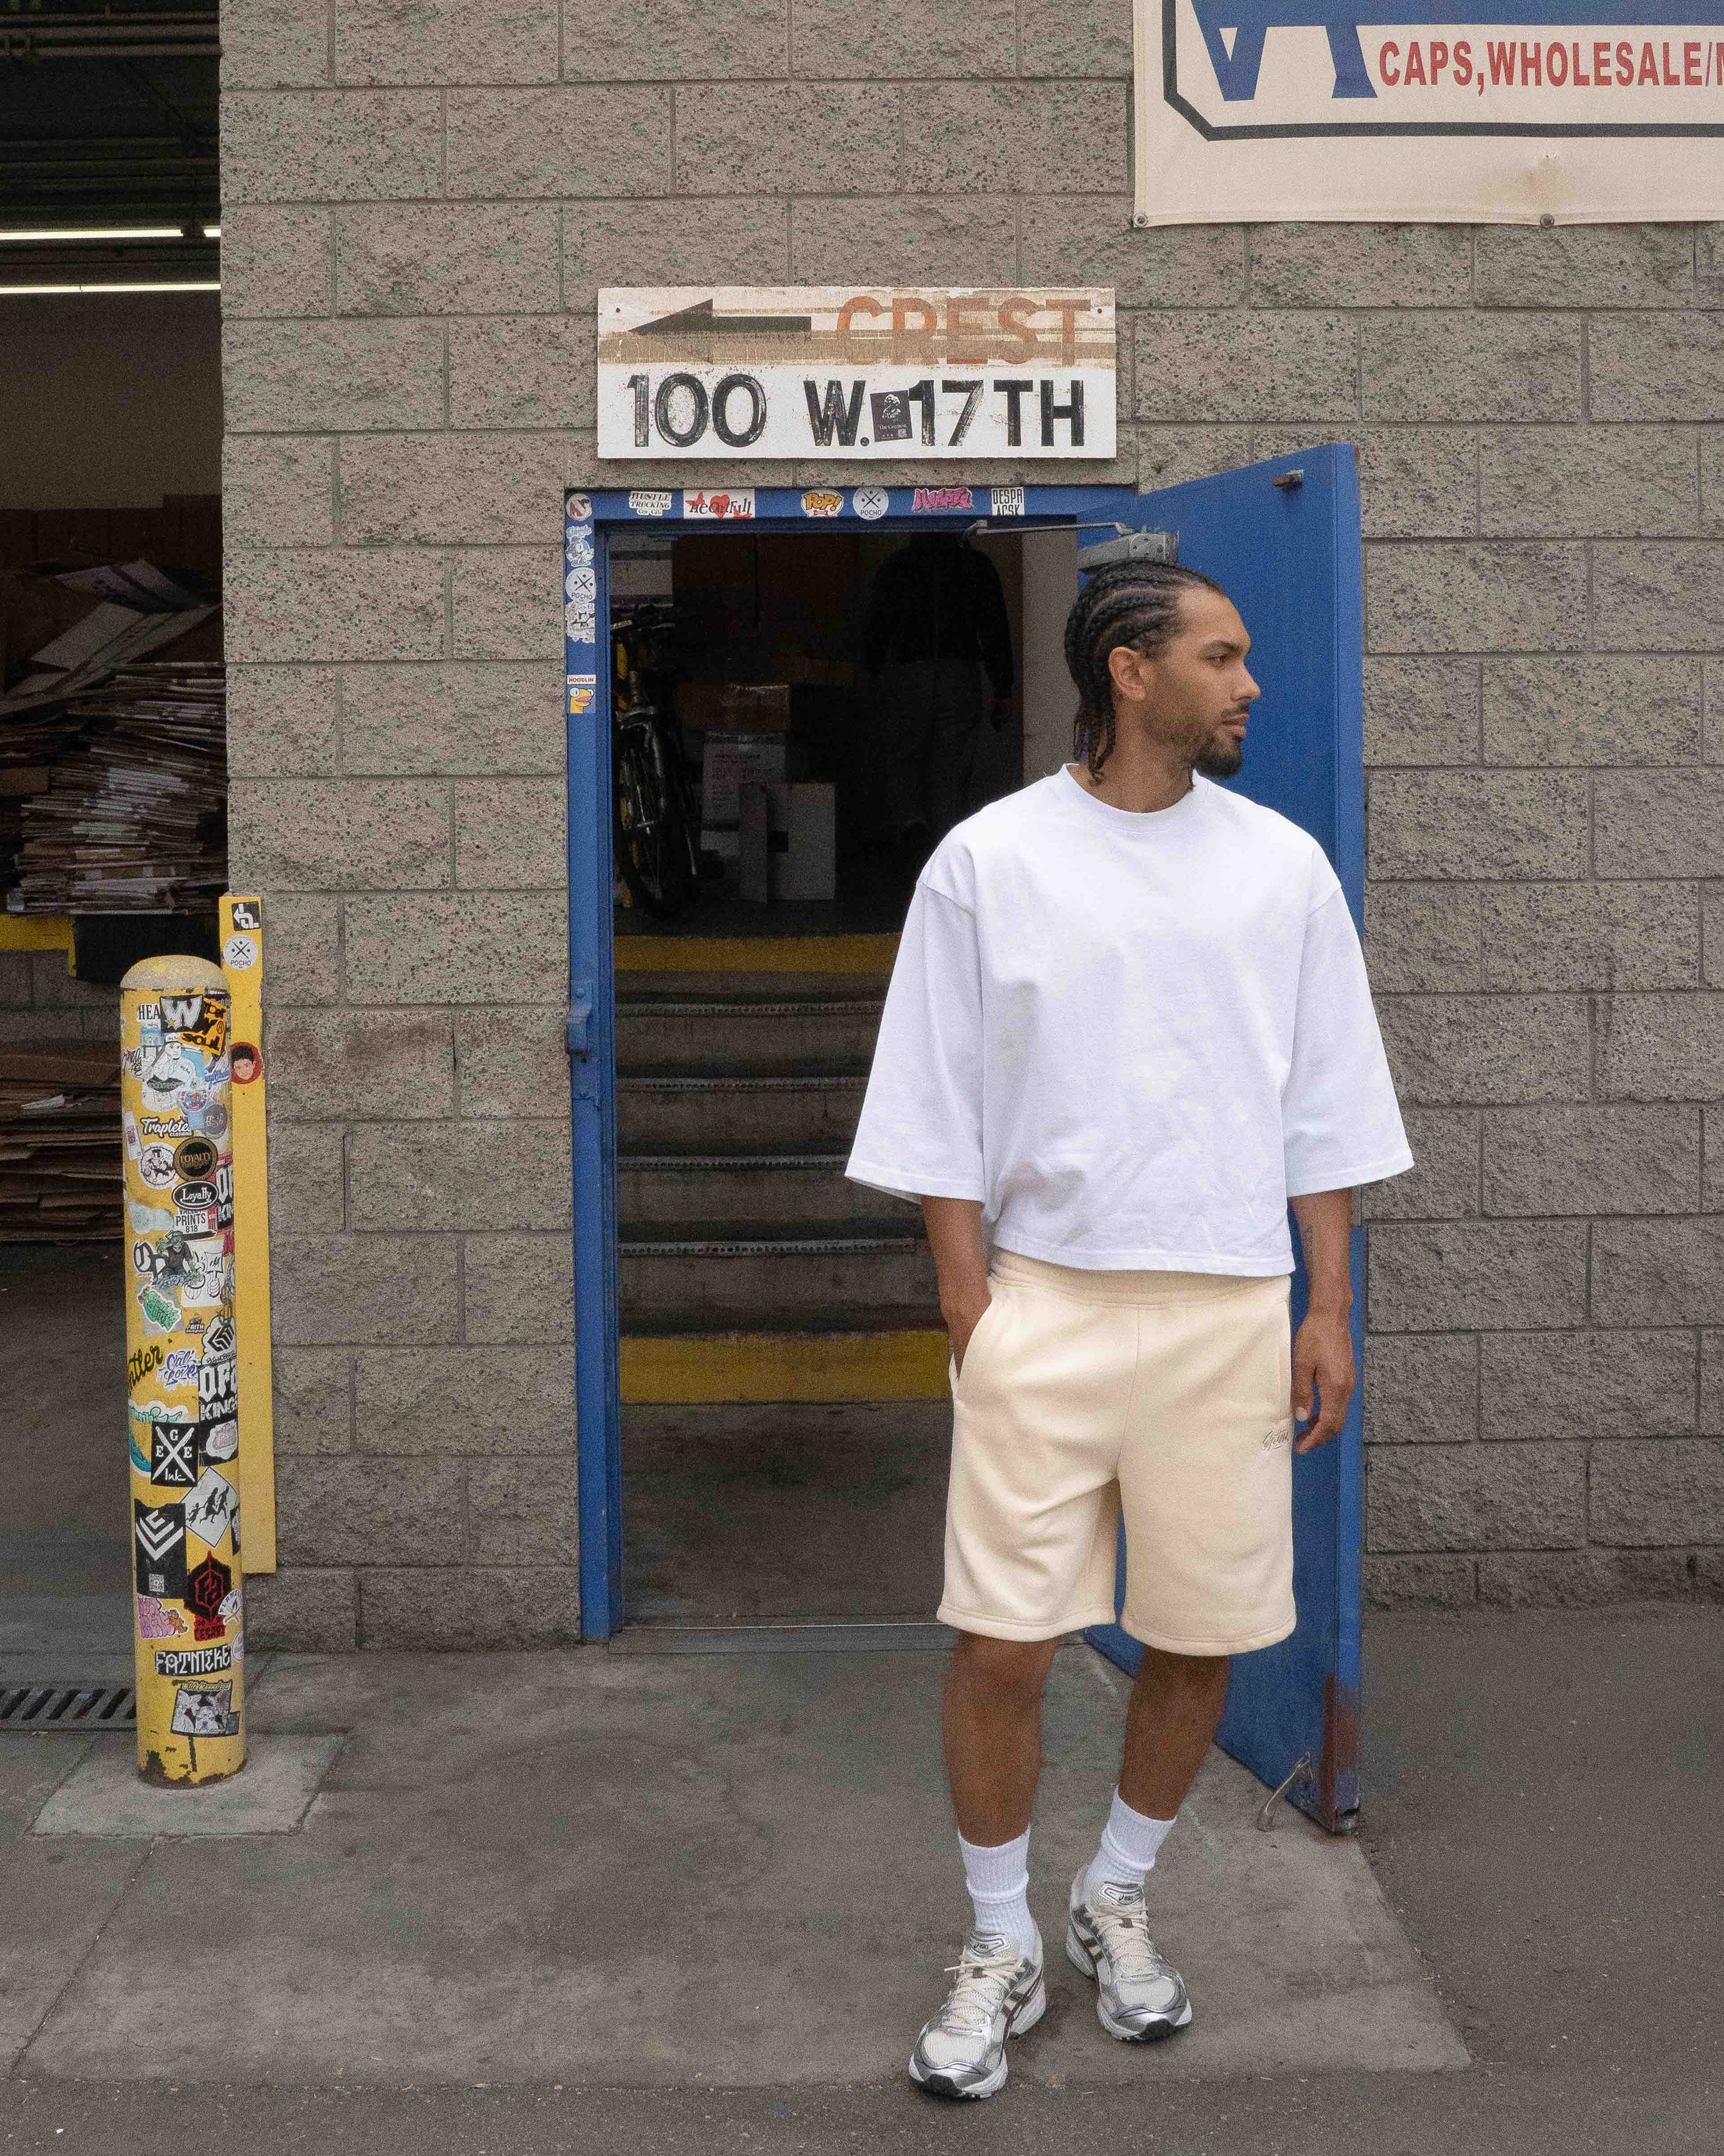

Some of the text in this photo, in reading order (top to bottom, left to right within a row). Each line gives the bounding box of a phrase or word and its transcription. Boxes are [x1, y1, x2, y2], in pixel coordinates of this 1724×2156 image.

[627, 374, 1084, 447] 100 W. 17TH
[631, 492, 670, 501] HUSTLE
[572, 592, 593, 600] POCHO
[175, 1213, 206, 1226] PRINTS
[165, 1469, 186, 1481] Ink
